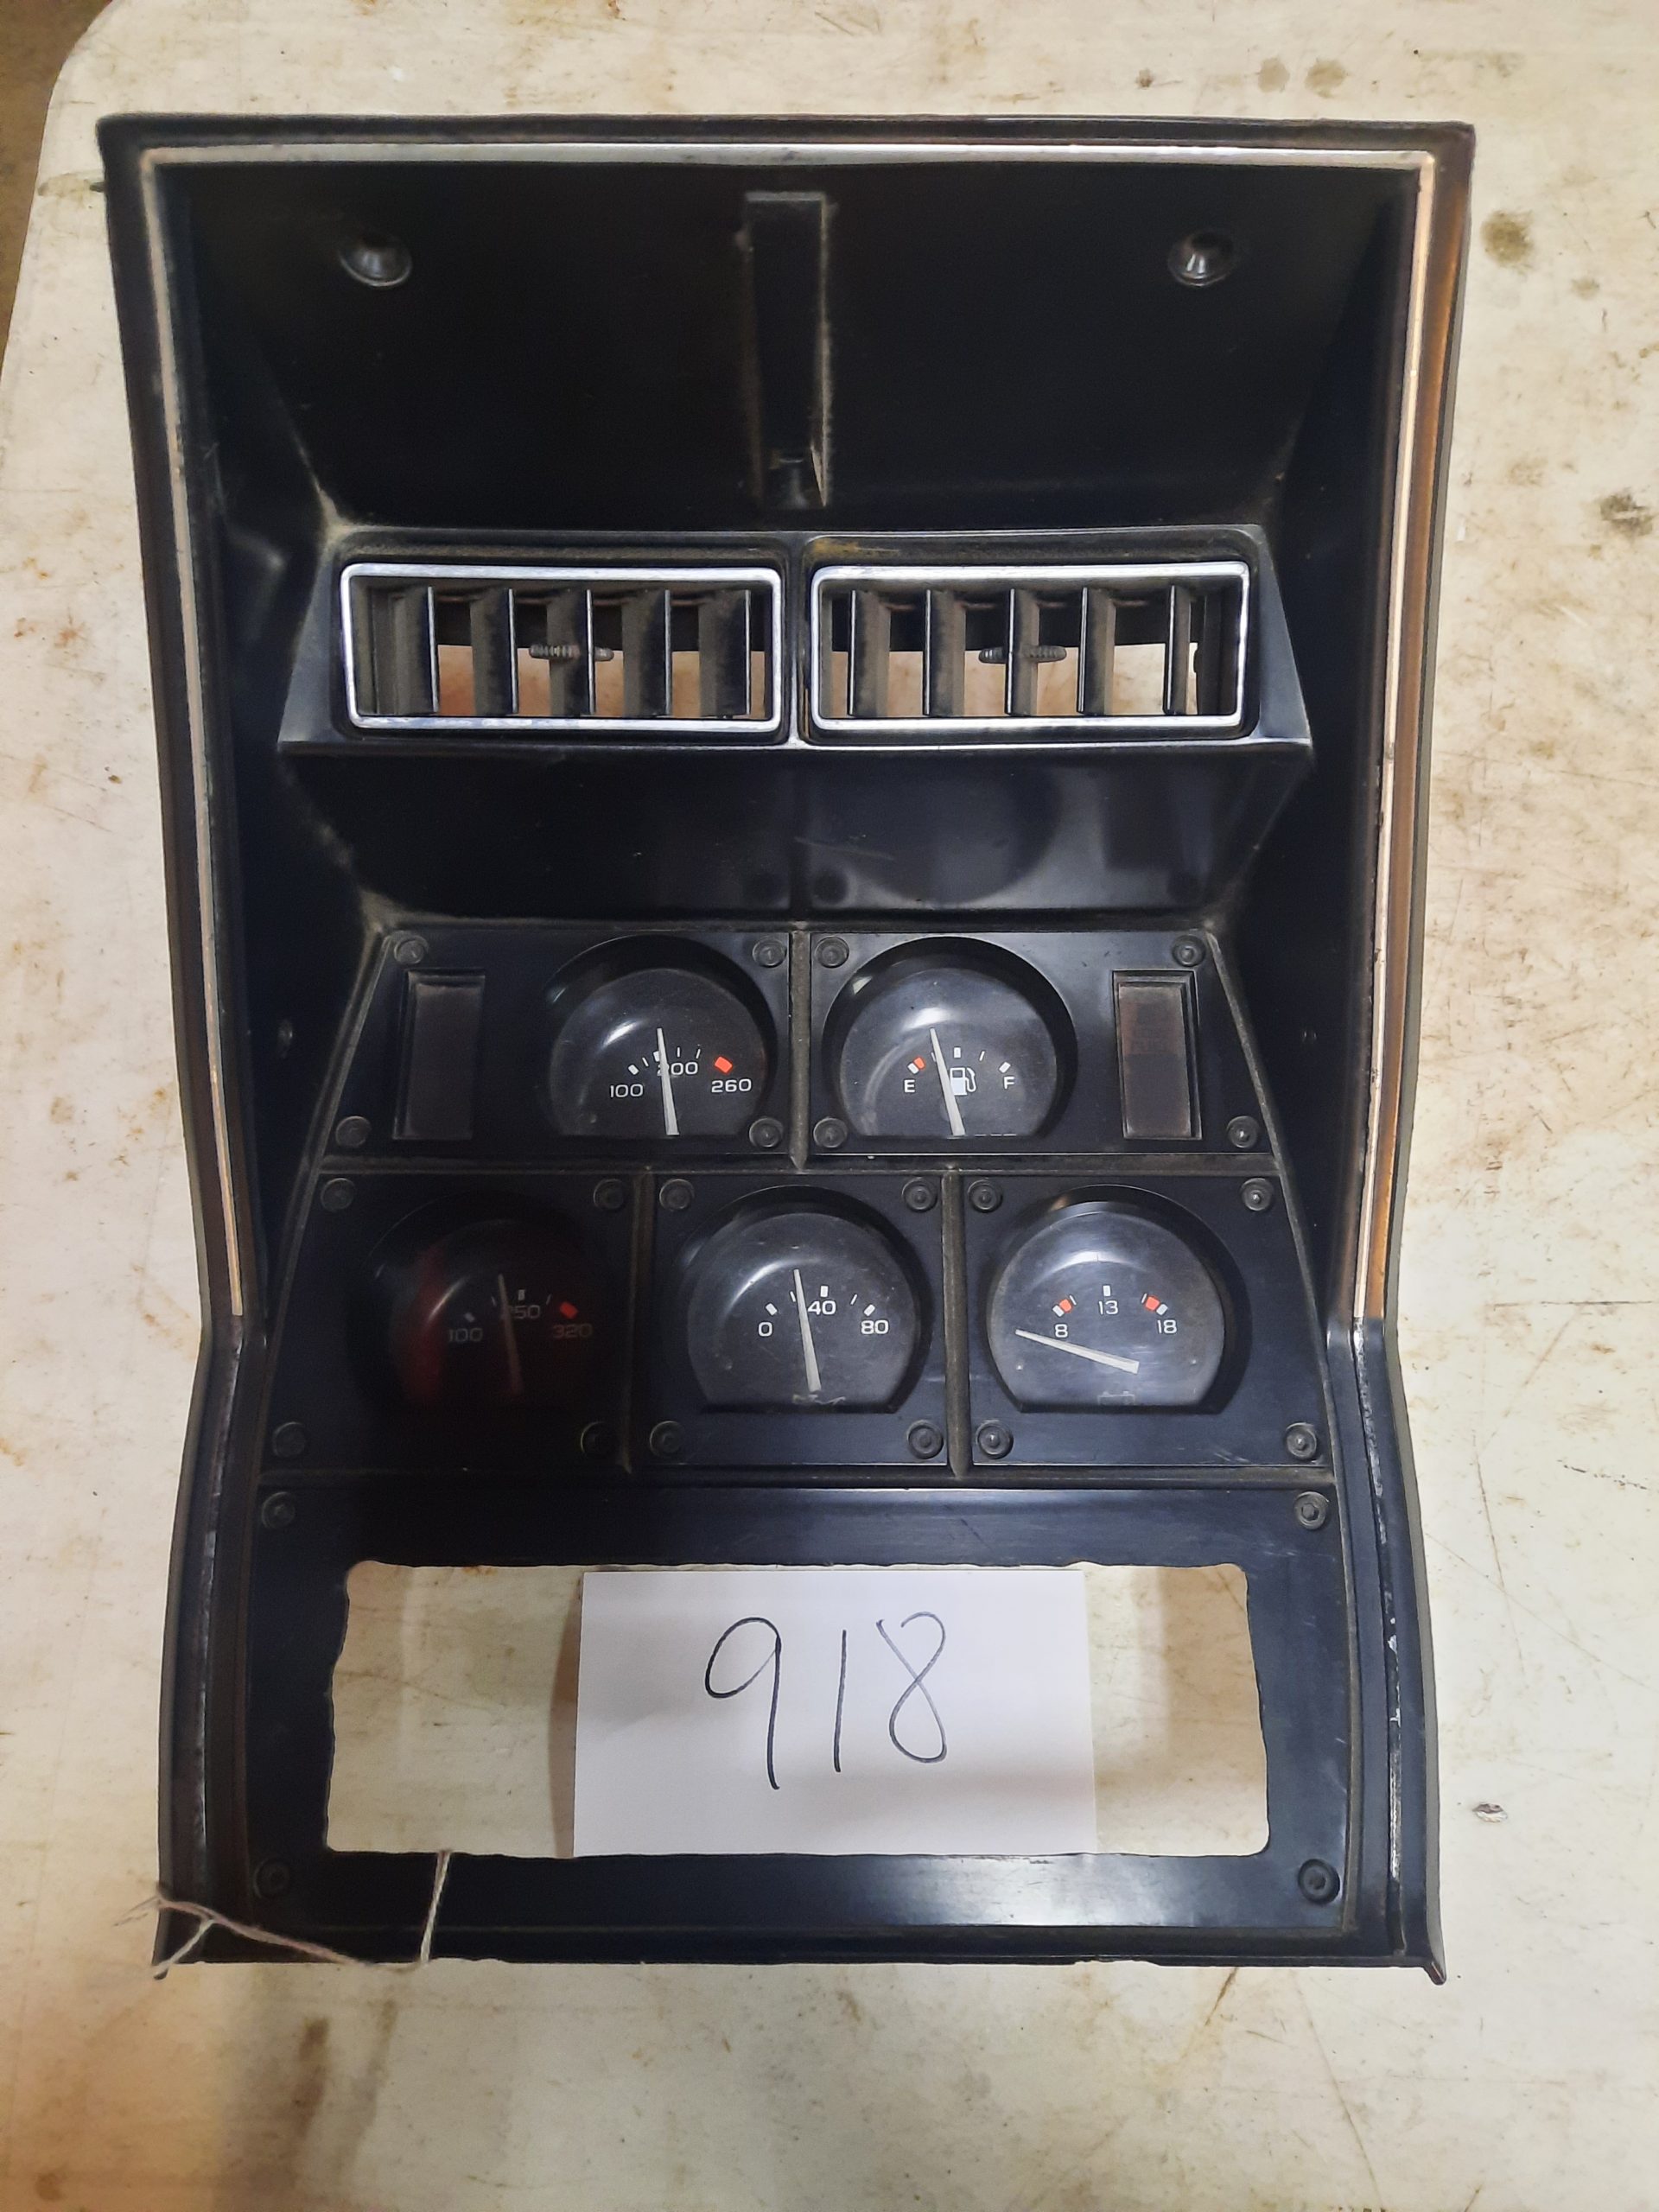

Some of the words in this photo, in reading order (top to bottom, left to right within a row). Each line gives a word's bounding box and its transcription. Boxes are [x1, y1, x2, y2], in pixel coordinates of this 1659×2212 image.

[610, 1084, 644, 1097] 100
[711, 1078, 752, 1093] 260
[904, 1079, 916, 1093] E
[1003, 1077, 1015, 1090] F
[500, 1305, 541, 1319] 50
[807, 1300, 836, 1315] 40
[1098, 1300, 1119, 1315] 13
[552, 1323, 594, 1338] 320
[758, 1322, 773, 1337] 0
[861, 1319, 889, 1335] 80
[1054, 1324, 1069, 1338] 8
[1157, 1319, 1178, 1334] 18
[448, 1327, 483, 1343] 100
[705, 1611, 947, 1790] 918
